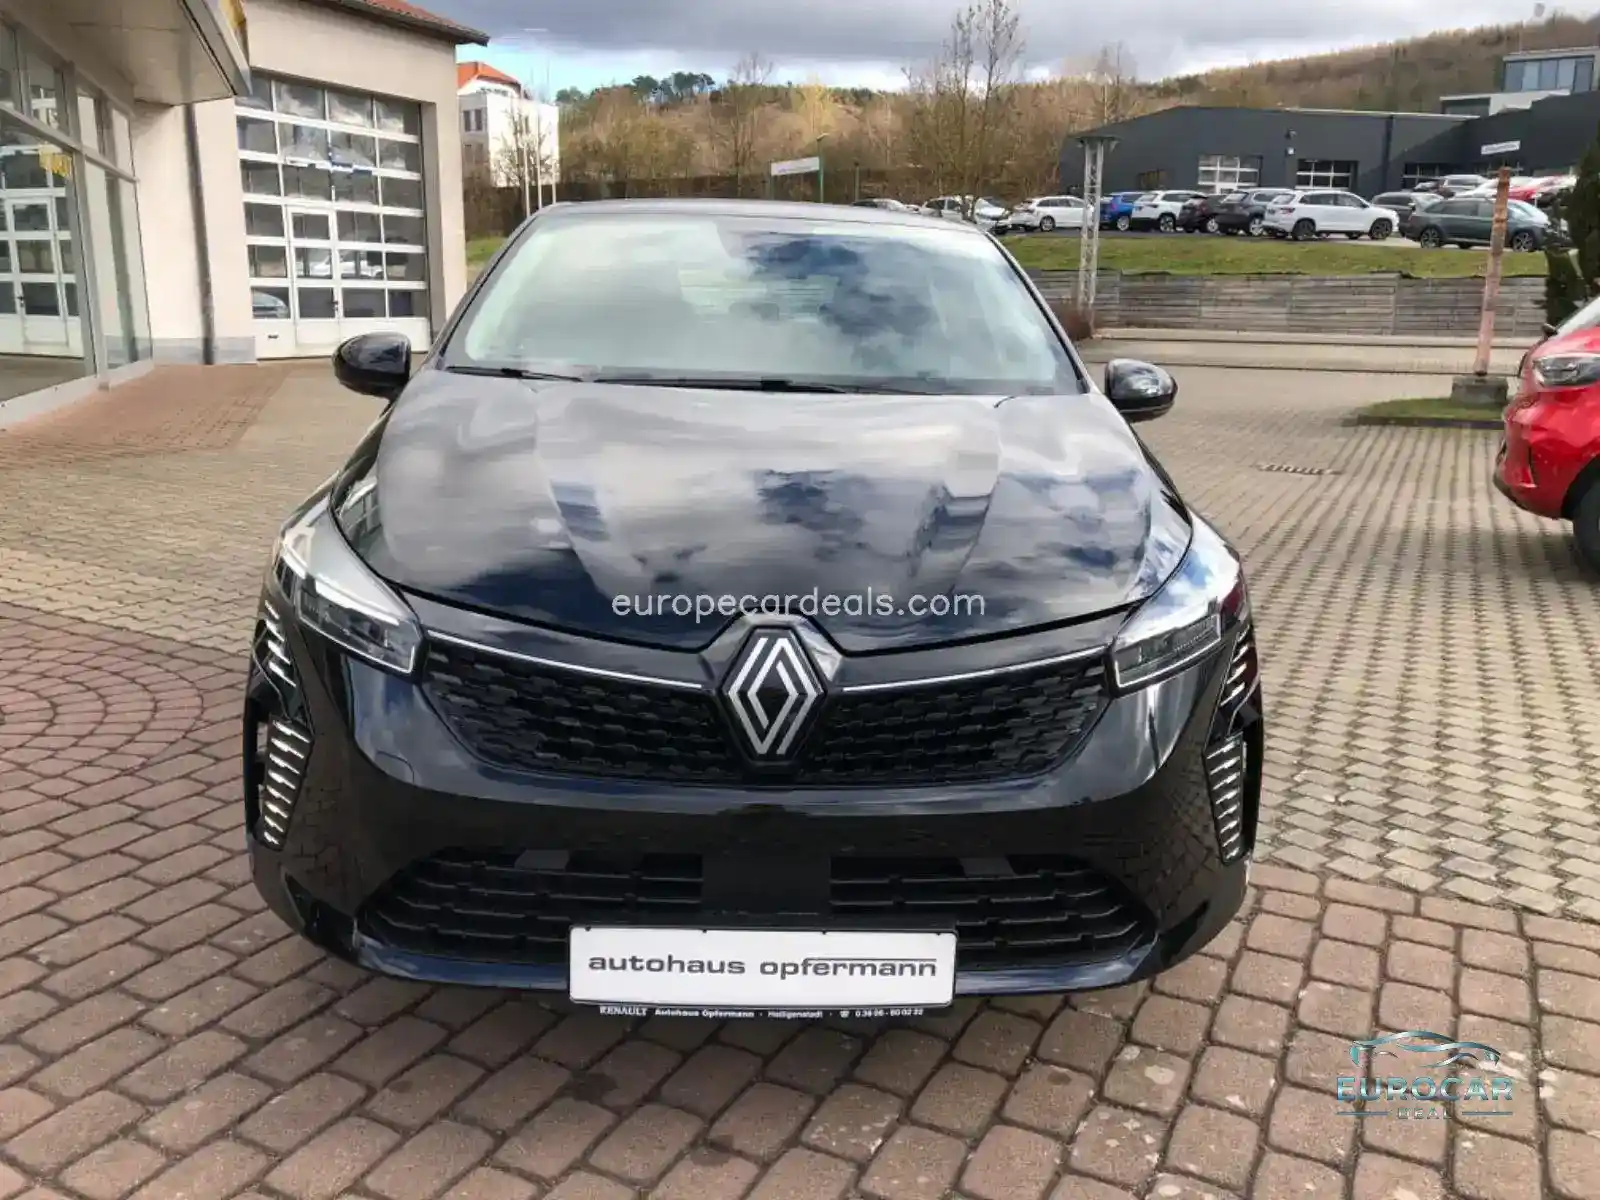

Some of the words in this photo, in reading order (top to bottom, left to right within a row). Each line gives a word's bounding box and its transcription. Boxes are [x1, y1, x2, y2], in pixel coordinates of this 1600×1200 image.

[588, 954, 746, 974] autohaus
[759, 957, 938, 980] opfermann
[599, 1006, 648, 1016] RENAULT
[654, 1008, 700, 1017] Autohaus
